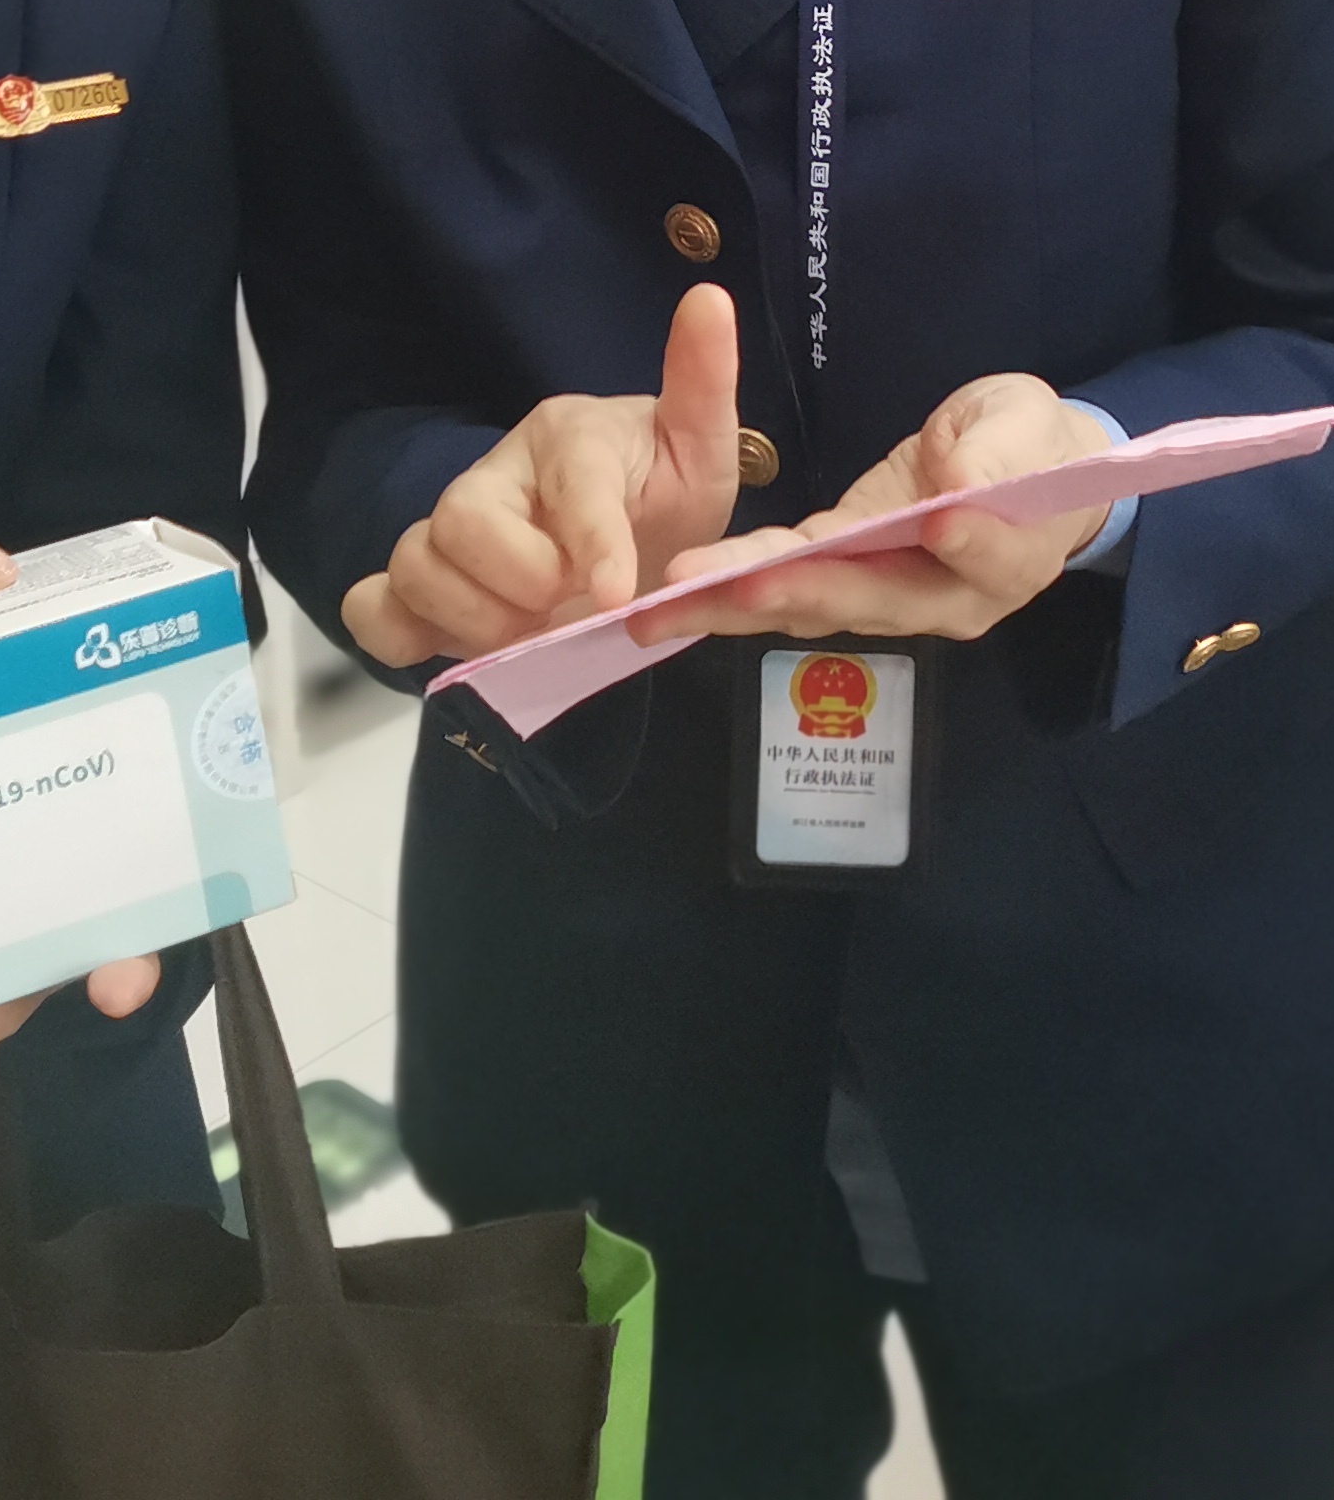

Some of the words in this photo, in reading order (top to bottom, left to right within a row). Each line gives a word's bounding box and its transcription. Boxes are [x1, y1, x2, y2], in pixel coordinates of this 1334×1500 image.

[807, 3, 835, 370] 中华人民共和国行政执法证
[766, 745, 896, 765] 中华人民共和国
[784, 767, 877, 788] 行政执法证
